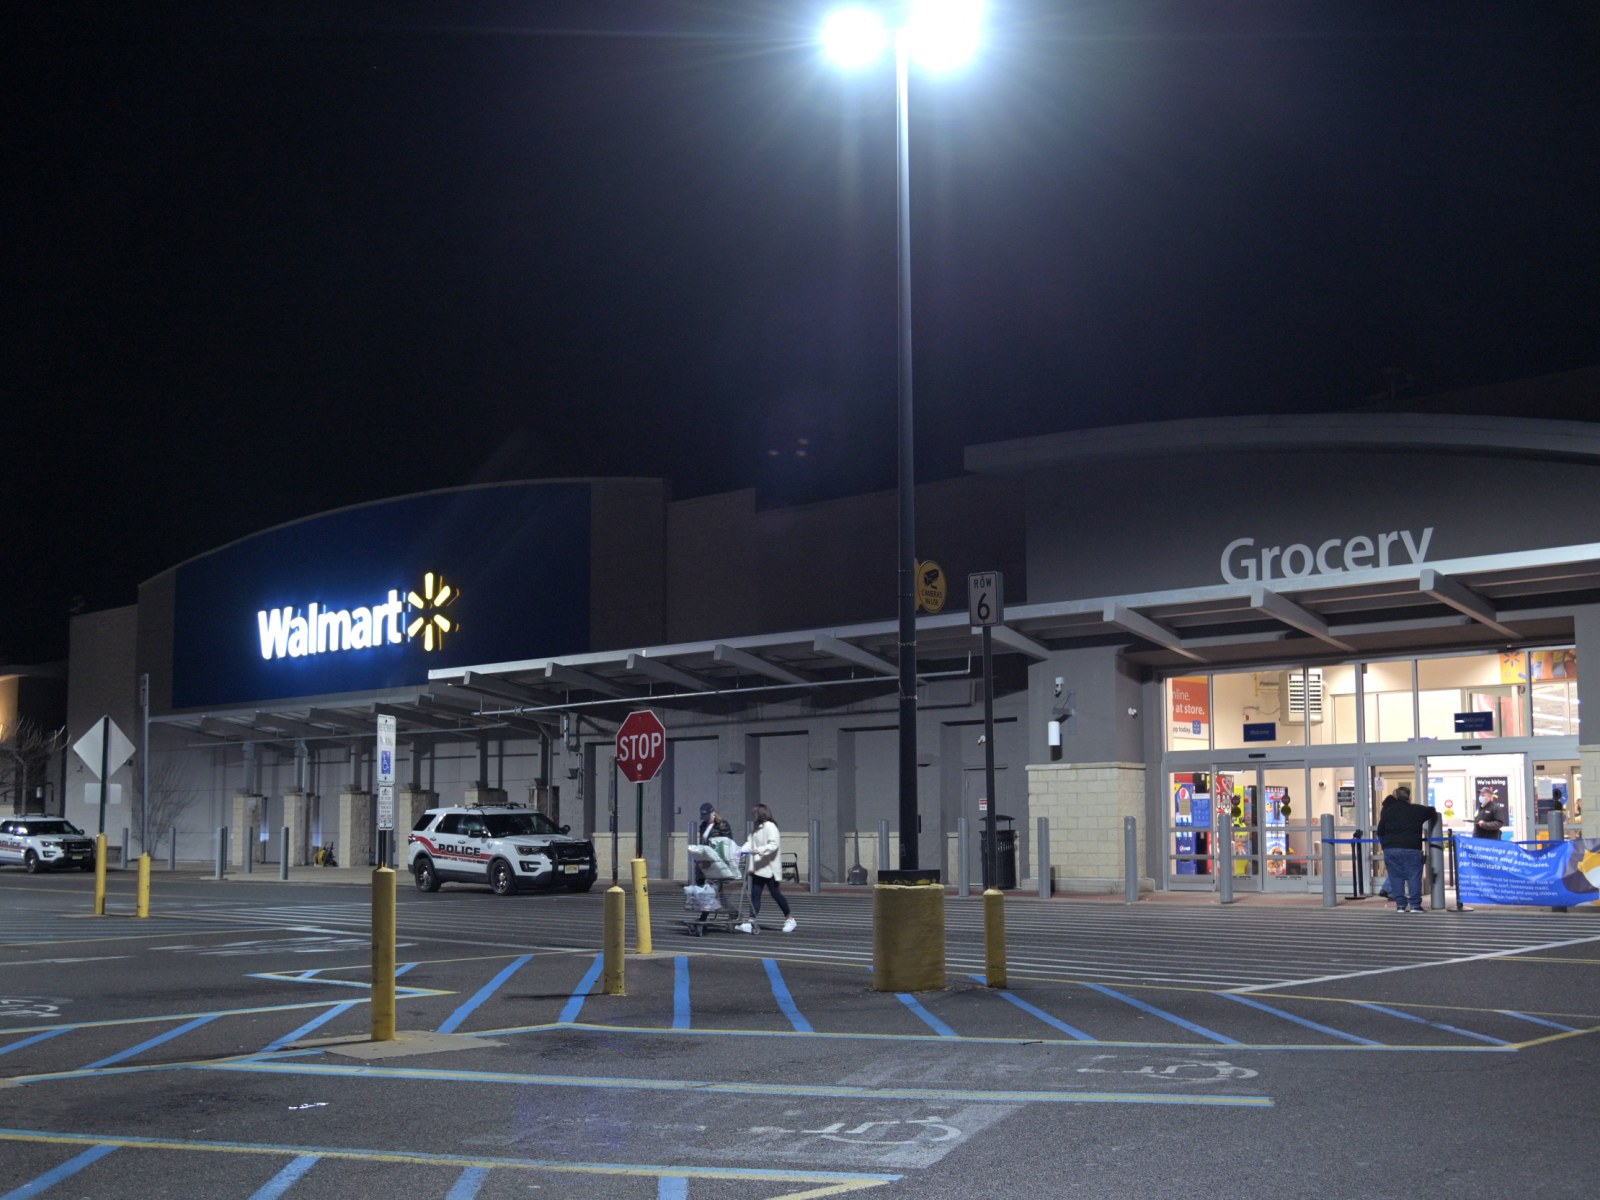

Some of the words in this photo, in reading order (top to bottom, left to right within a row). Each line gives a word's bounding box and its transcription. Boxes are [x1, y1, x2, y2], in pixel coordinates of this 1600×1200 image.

[1220, 527, 1434, 584] Grocery
[974, 577, 992, 588] ROW
[921, 590, 942, 598] CAMERAS
[977, 593, 990, 620] 6
[257, 589, 403, 660] Walmart
[1176, 704, 1183, 713] at
[1184, 704, 1205, 715] store.
[620, 732, 662, 761] STOP
[438, 843, 481, 856] POLICE
[1474, 845, 1505, 854] coverings
[1519, 851, 1547, 861] reqed
[1468, 853, 1499, 861] customers
[1499, 856, 1513, 864] and
